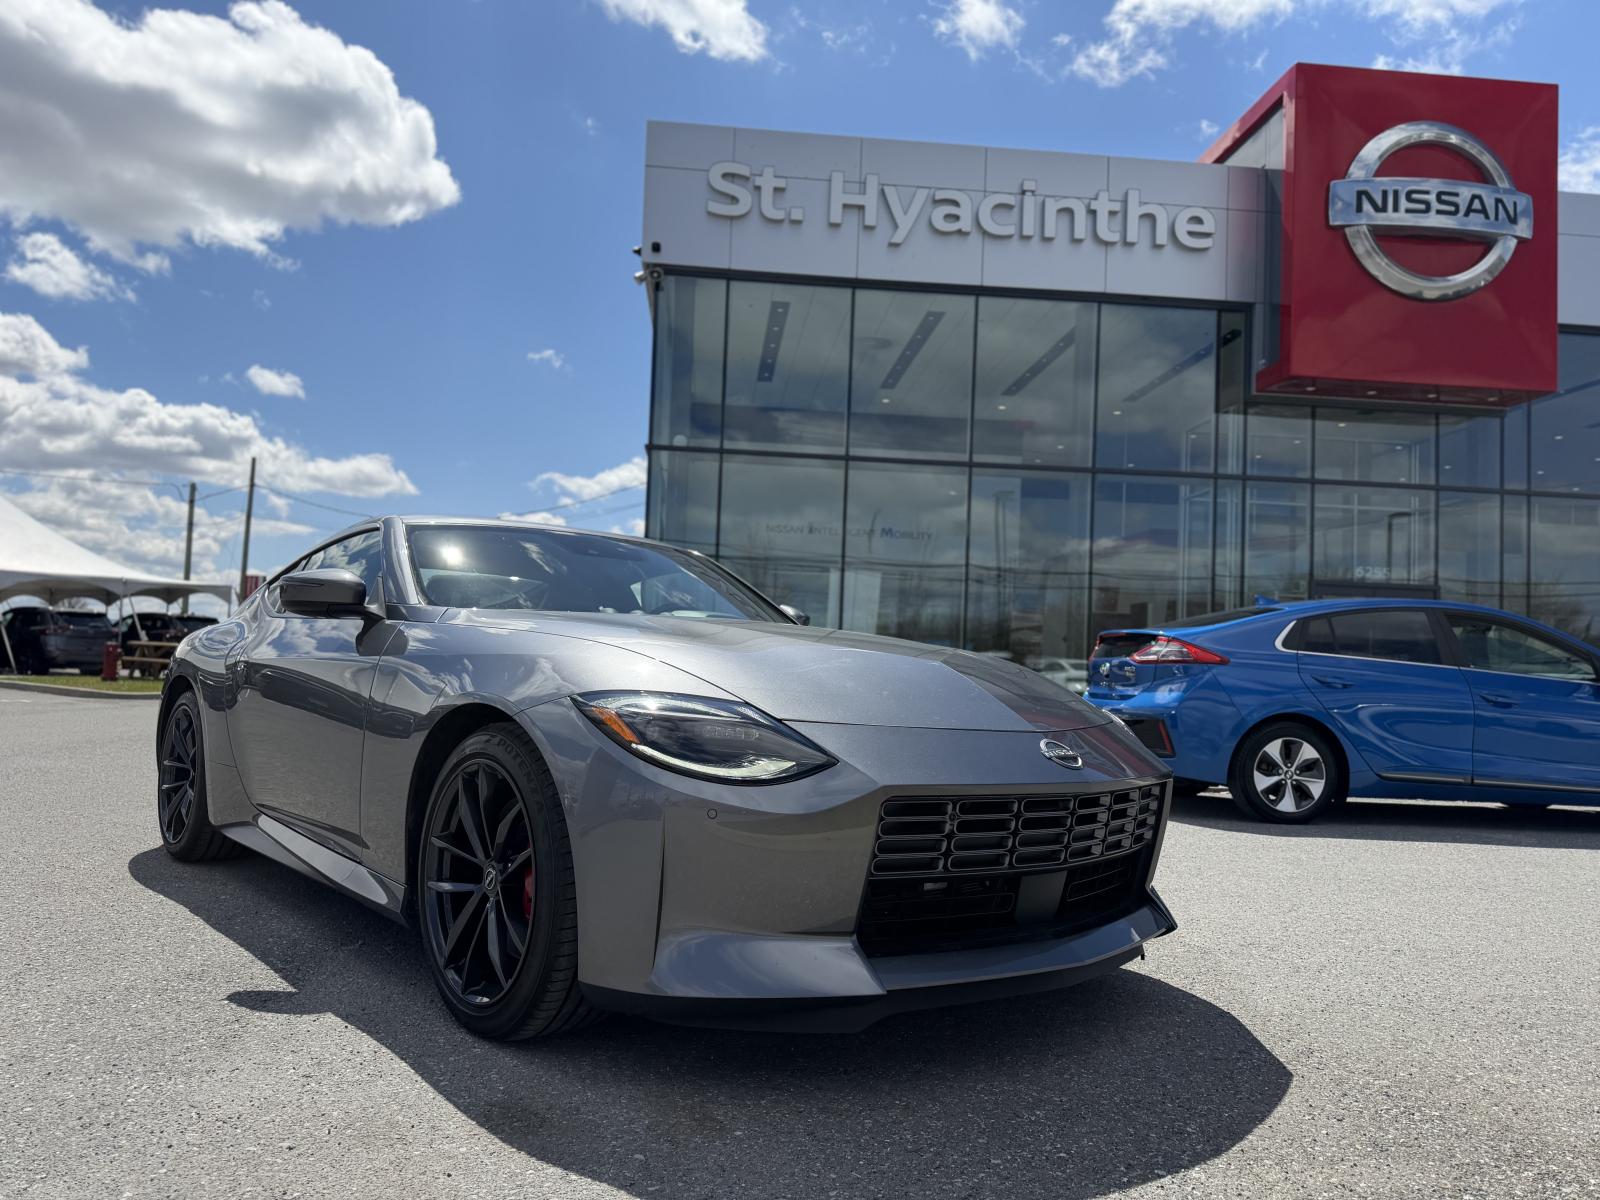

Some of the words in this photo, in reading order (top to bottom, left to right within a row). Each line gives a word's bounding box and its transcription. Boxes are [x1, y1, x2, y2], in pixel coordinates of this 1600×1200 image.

[706, 161, 804, 223] St.
[829, 170, 1216, 250] Hyacinthe
[1356, 188, 1518, 225] NISSAN
[766, 523, 804, 534] NISSAN
[808, 522, 875, 537] INTELGENT
[1356, 566, 1391, 578] 6255
